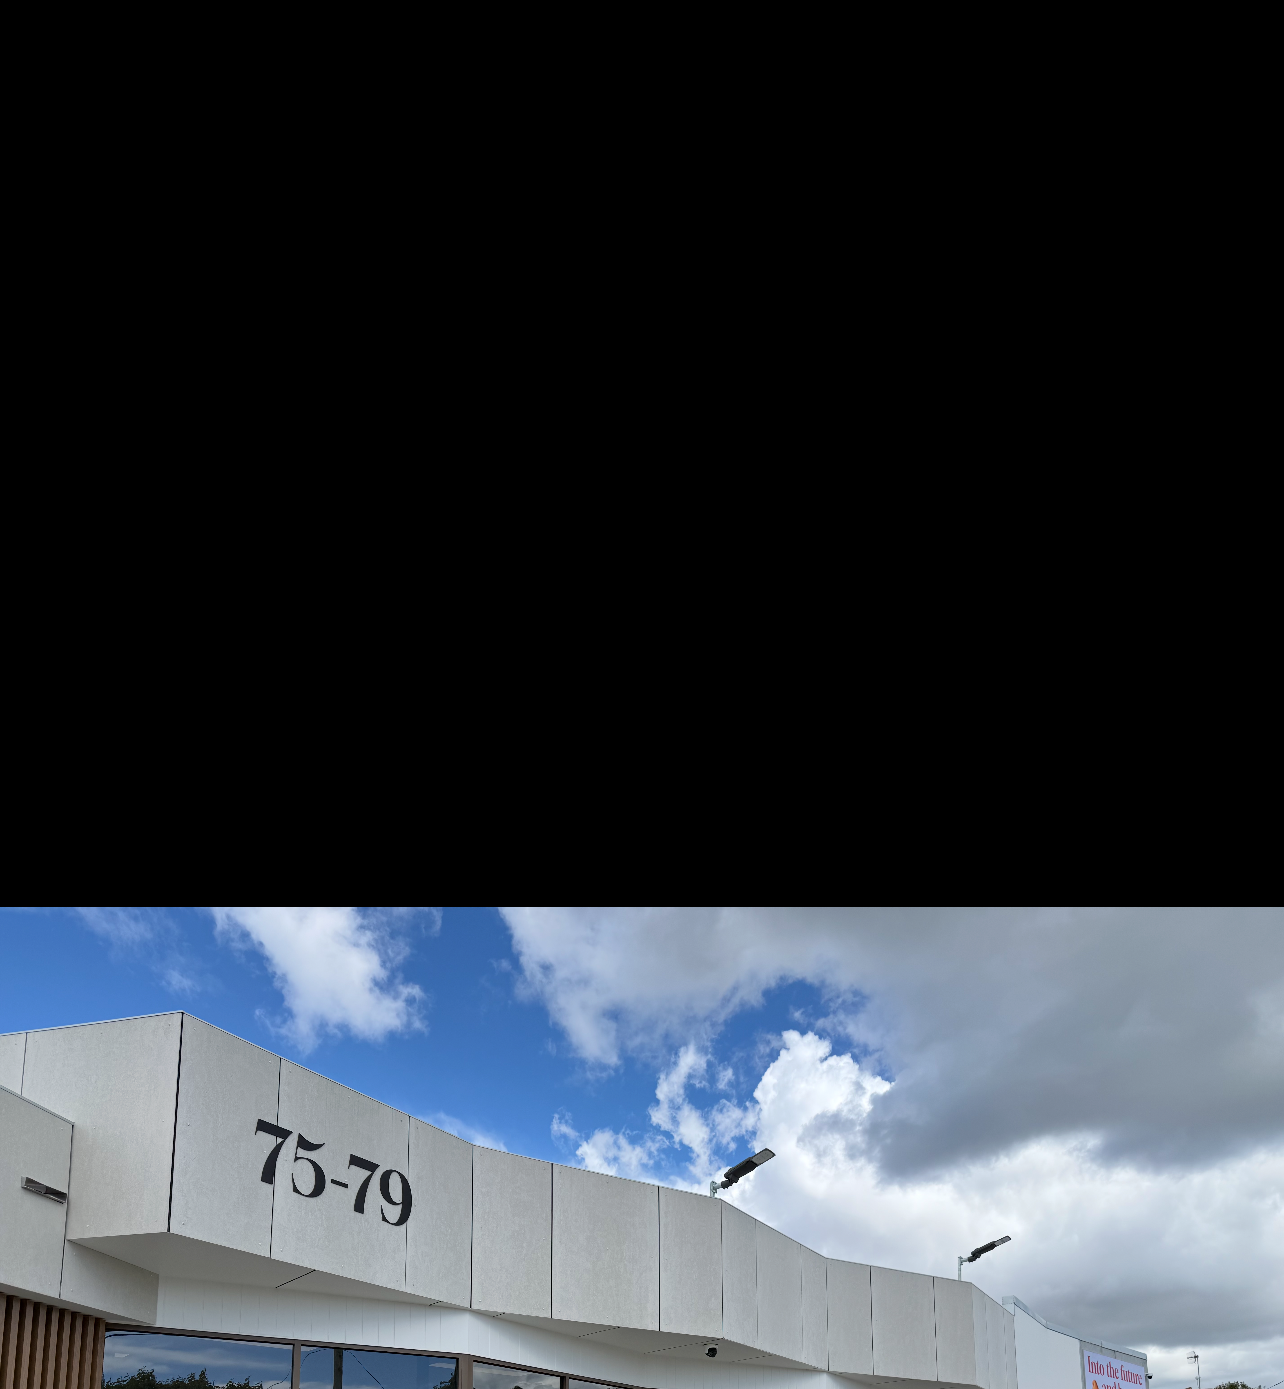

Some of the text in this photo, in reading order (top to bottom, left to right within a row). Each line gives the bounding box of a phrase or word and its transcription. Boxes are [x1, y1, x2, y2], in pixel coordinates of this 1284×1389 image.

[255, 1119, 412, 1226] 75-79
[1087, 1356, 1142, 1385] Into the future
